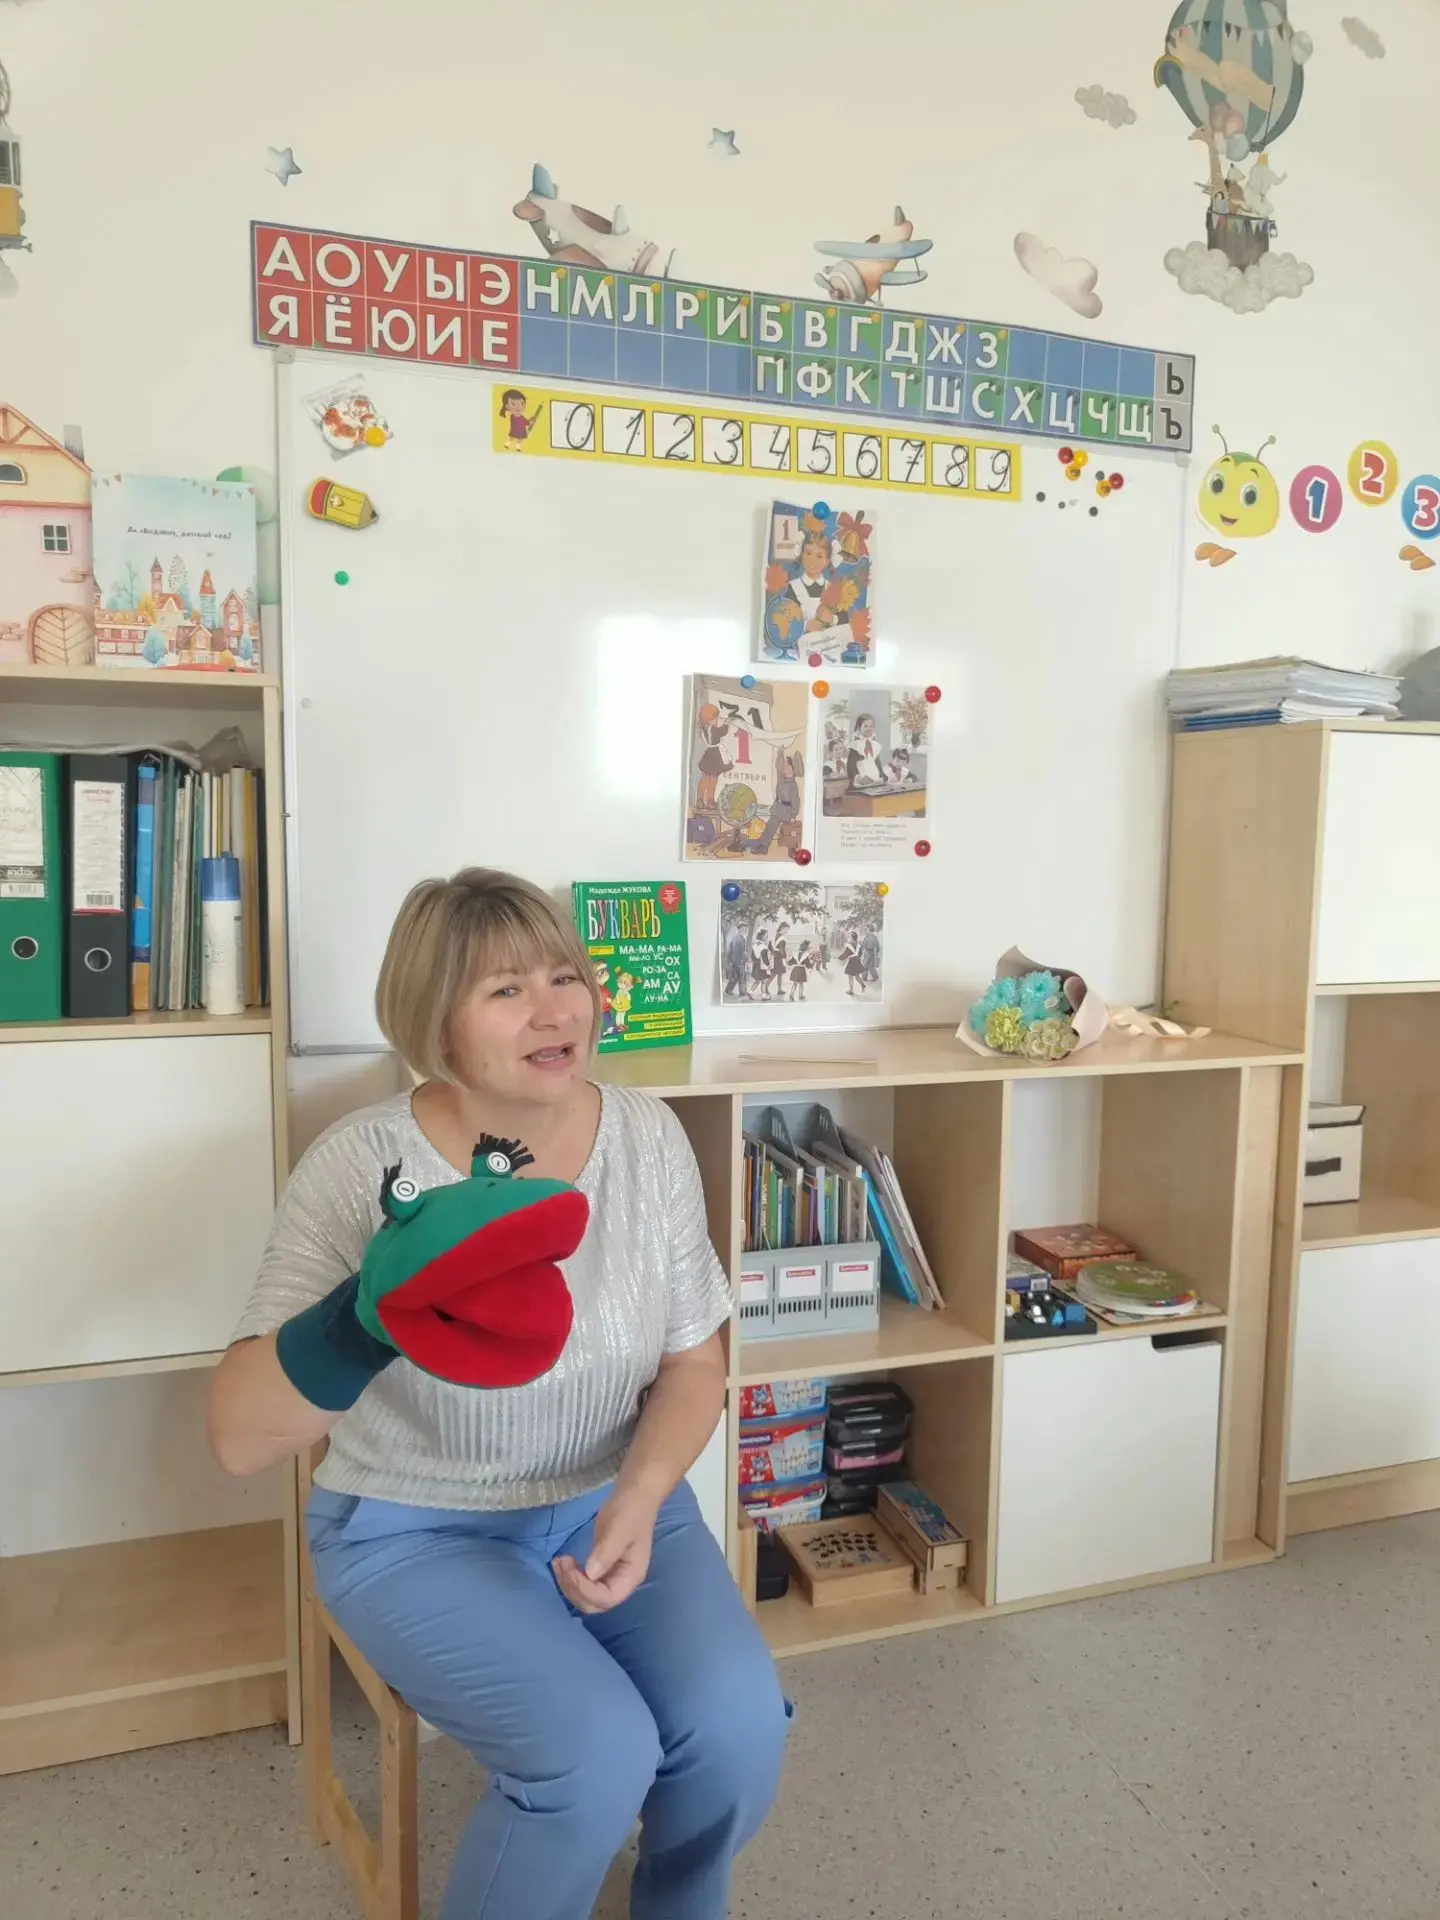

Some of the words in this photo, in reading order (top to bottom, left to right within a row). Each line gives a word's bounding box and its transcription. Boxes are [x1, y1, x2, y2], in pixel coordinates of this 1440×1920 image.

[262, 236, 306, 282] А
[316, 243, 361, 287] О
[373, 250, 410, 293] У
[426, 257, 465, 302] Ы
[480, 263, 510, 306] Э
[526, 268, 560, 313] Н
[571, 275, 613, 320] М
[622, 284, 655, 325] Л
[675, 291, 700, 330] Р
[717, 296, 748, 339] Й
[760, 304, 783, 343] Б
[804, 310, 828, 348] В
[850, 315, 873, 352] Г
[885, 321, 918, 365] Д
[927, 325, 963, 366] Ж
[975, 332, 998, 369] З
[1167, 362, 1185, 395] Ь
[267, 295, 299, 338] Я
[325, 295, 352, 345] Ё
[371, 306, 416, 353] Ю
[426, 314, 462, 358] И
[482, 320, 509, 363] Е
[757, 354, 784, 394] П
[796, 362, 832, 398] Ф
[846, 366, 872, 404] К
[891, 370, 915, 408] Т
[926, 375, 962, 414] Ш
[971, 382, 996, 419] С
[1009, 386, 1037, 424] Х
[1049, 391, 1075, 433] Ц
[1088, 397, 1109, 433] Ч
[1119, 402, 1152, 442] Щ
[1160, 408, 1183, 440] Ъ
[566, 403, 595, 449] 0
[626, 409, 645, 455] 1
[665, 415, 695, 460] 2
[714, 420, 743, 464] 3
[769, 425, 791, 470] 4
[807, 429, 837, 474] 5
[856, 435, 882, 478] 6
[901, 439, 926, 482] 7
[945, 444, 969, 487] 8
[987, 450, 1011, 491] 9
[1306, 476, 1328, 523] 1
[1360, 449, 1386, 498] 2
[1412, 486, 1440, 531] 3
[782, 520, 789, 541] 1
[734, 727, 752, 764] 1
[722, 772, 767, 782] СЕНТЯБРЯ
[589, 887, 620, 895] Надежда
[622, 886, 652, 894] ЖУКОВА
[587, 898, 660, 940] БУКВАРЬ
[619, 944, 654, 954] МА-МА
[657, 944, 682, 953] РА-МА
[653, 953, 664, 961] УС
[665, 956, 680, 966] ОХ
[642, 966, 667, 974] РО-ЗА
[667, 972, 680, 980] СА
[643, 979, 660, 989] АМ
[663, 981, 681, 994] АУ
